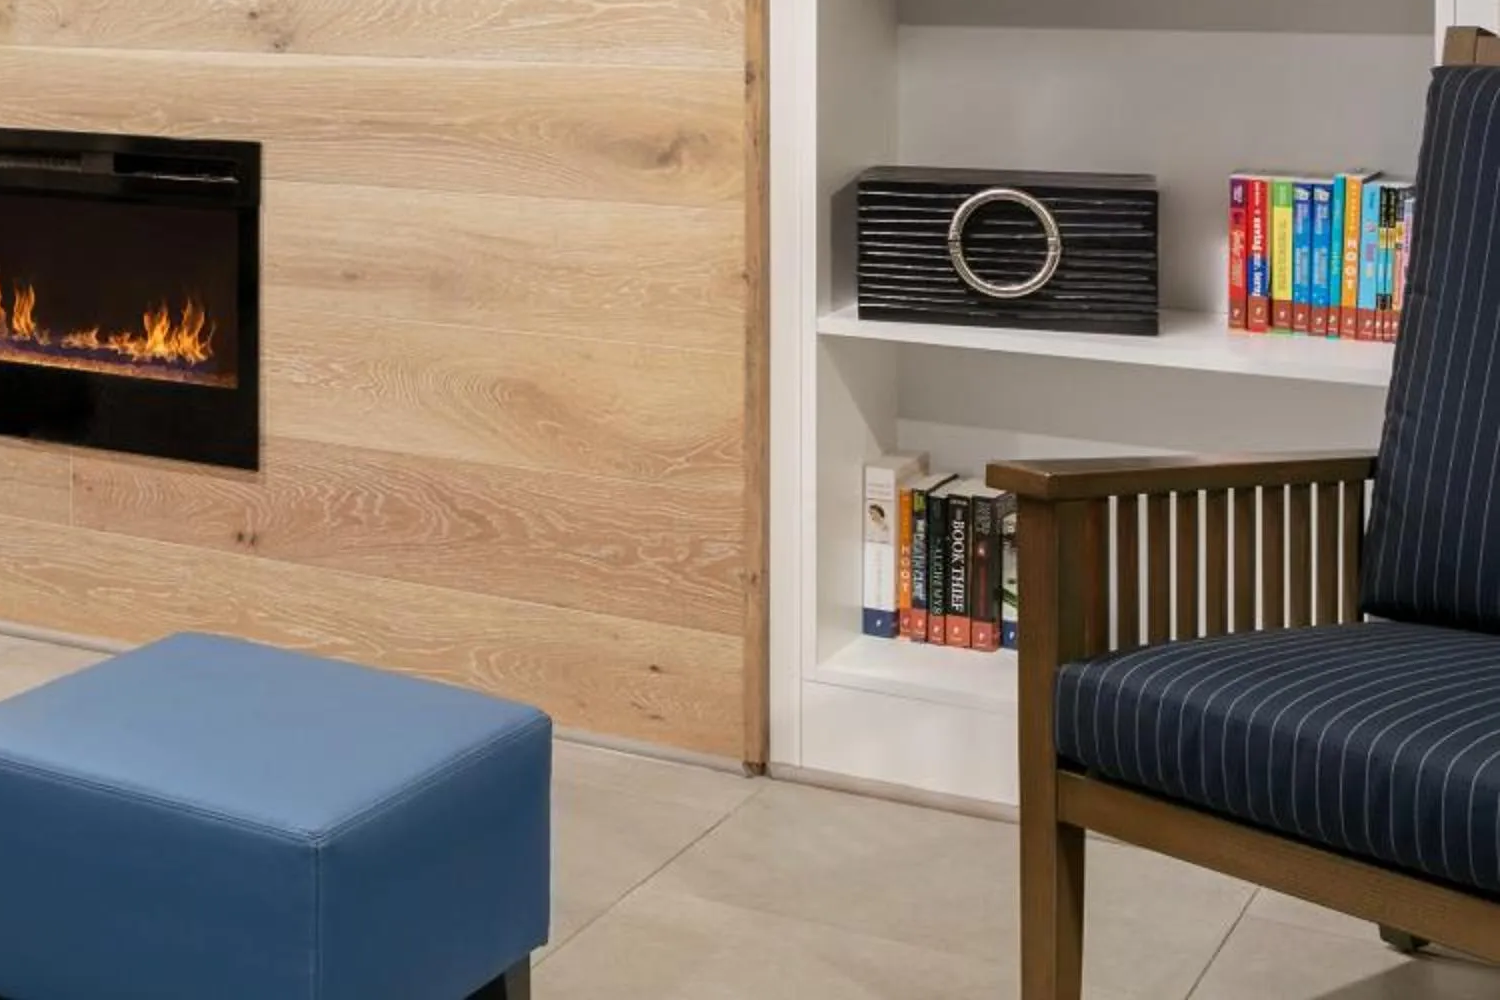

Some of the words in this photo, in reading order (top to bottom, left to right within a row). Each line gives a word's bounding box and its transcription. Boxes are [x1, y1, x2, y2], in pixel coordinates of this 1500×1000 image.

[1345, 239, 1358, 289] HOOT
[951, 519, 966, 562] BOOK
[951, 564, 966, 613] THIEF
